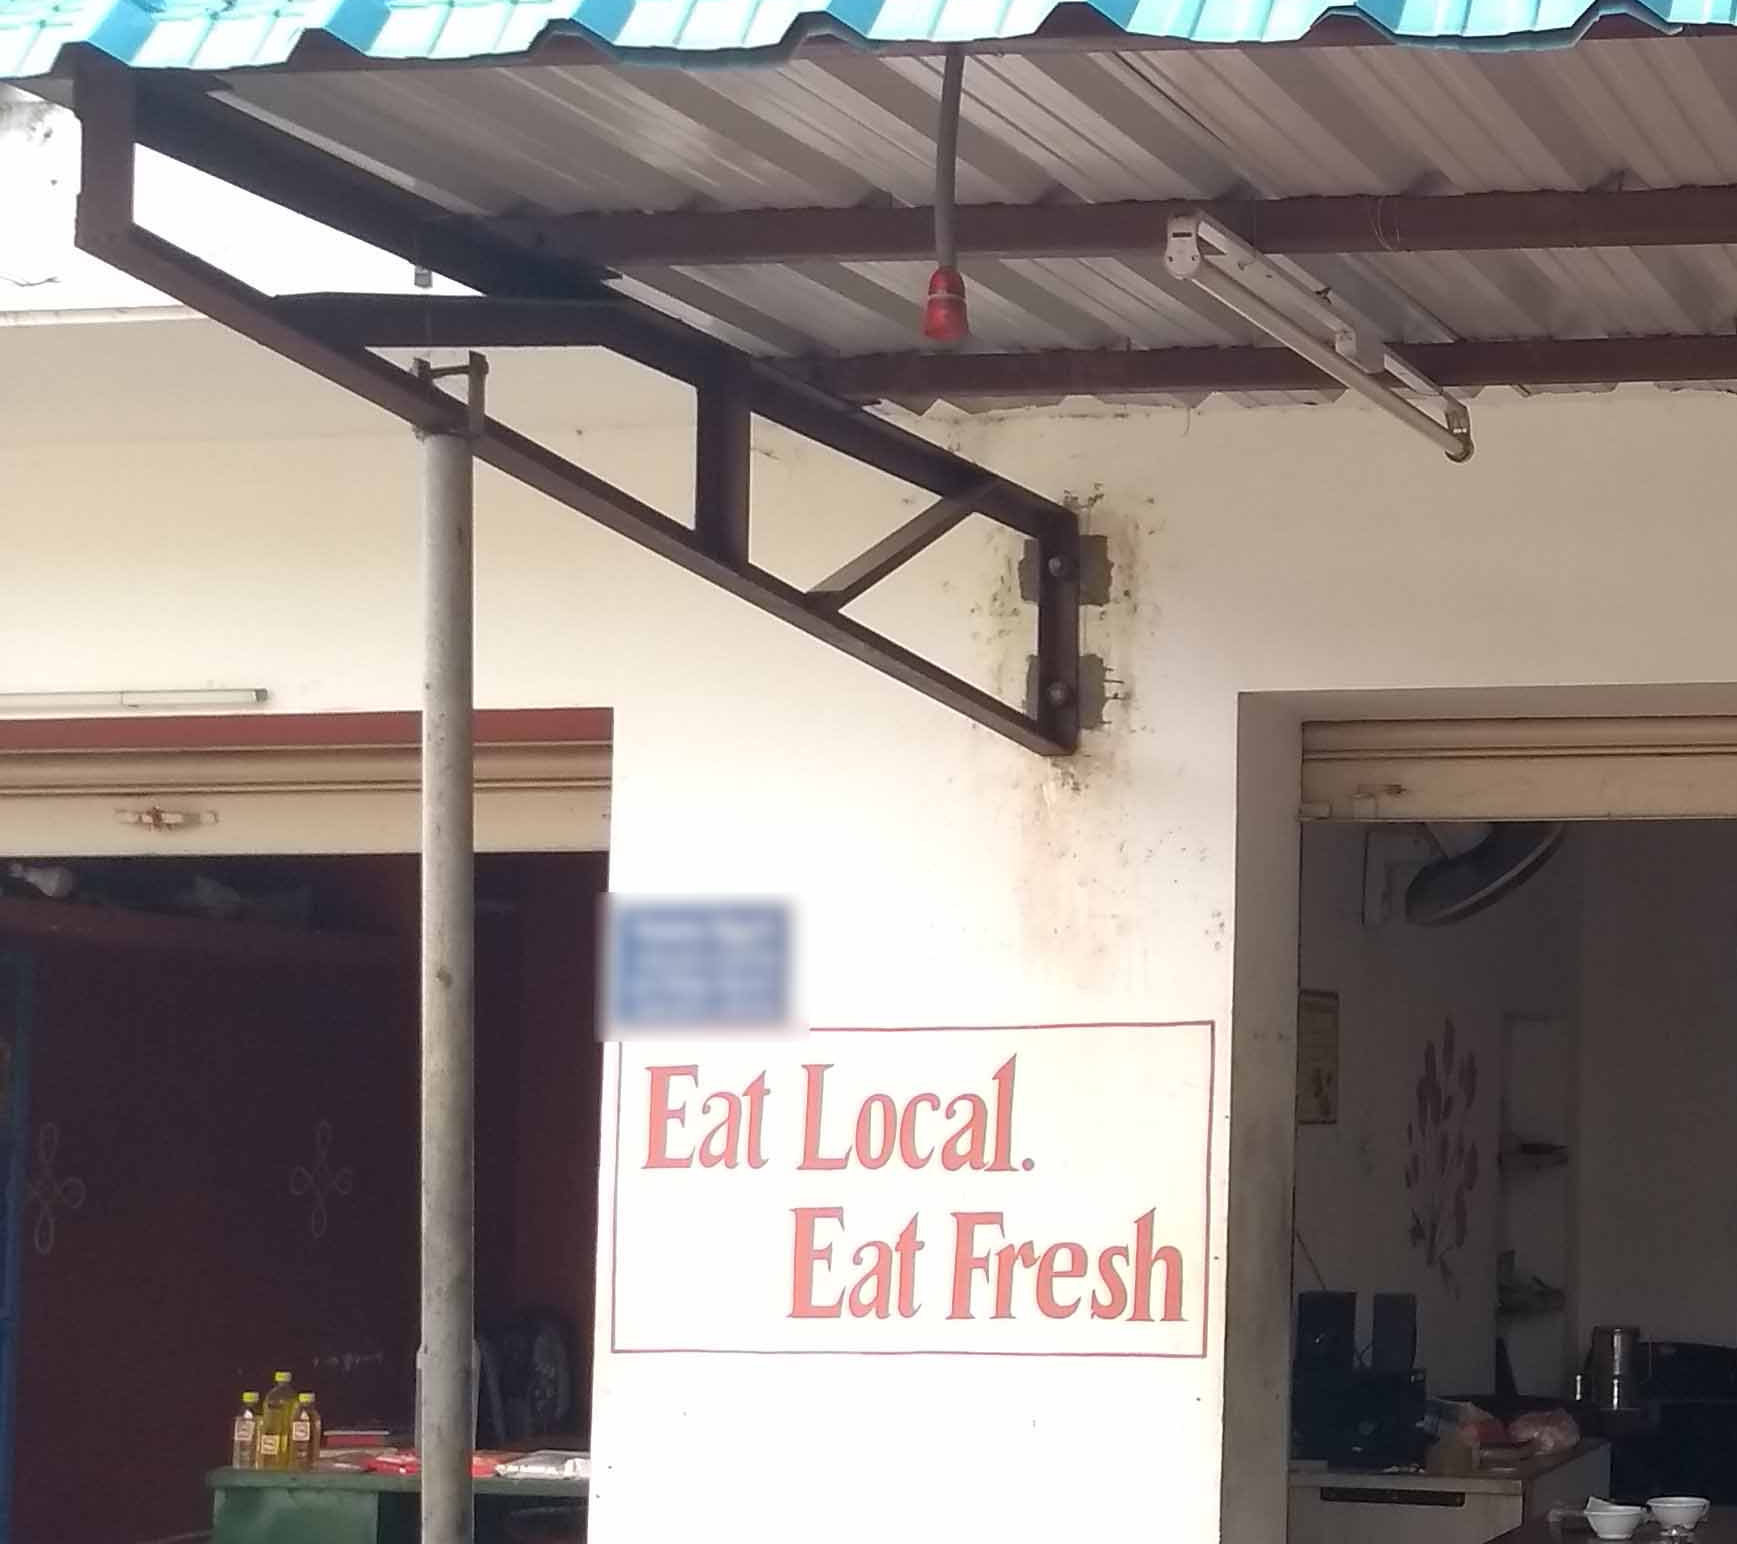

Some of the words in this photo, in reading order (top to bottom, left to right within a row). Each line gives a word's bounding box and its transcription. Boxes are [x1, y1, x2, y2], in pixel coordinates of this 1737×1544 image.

[641, 1064, 771, 1170] Eat
[796, 1053, 1035, 1172] Local.
[786, 1206, 925, 1319] Eat
[945, 1207, 1188, 1323] Fresh
